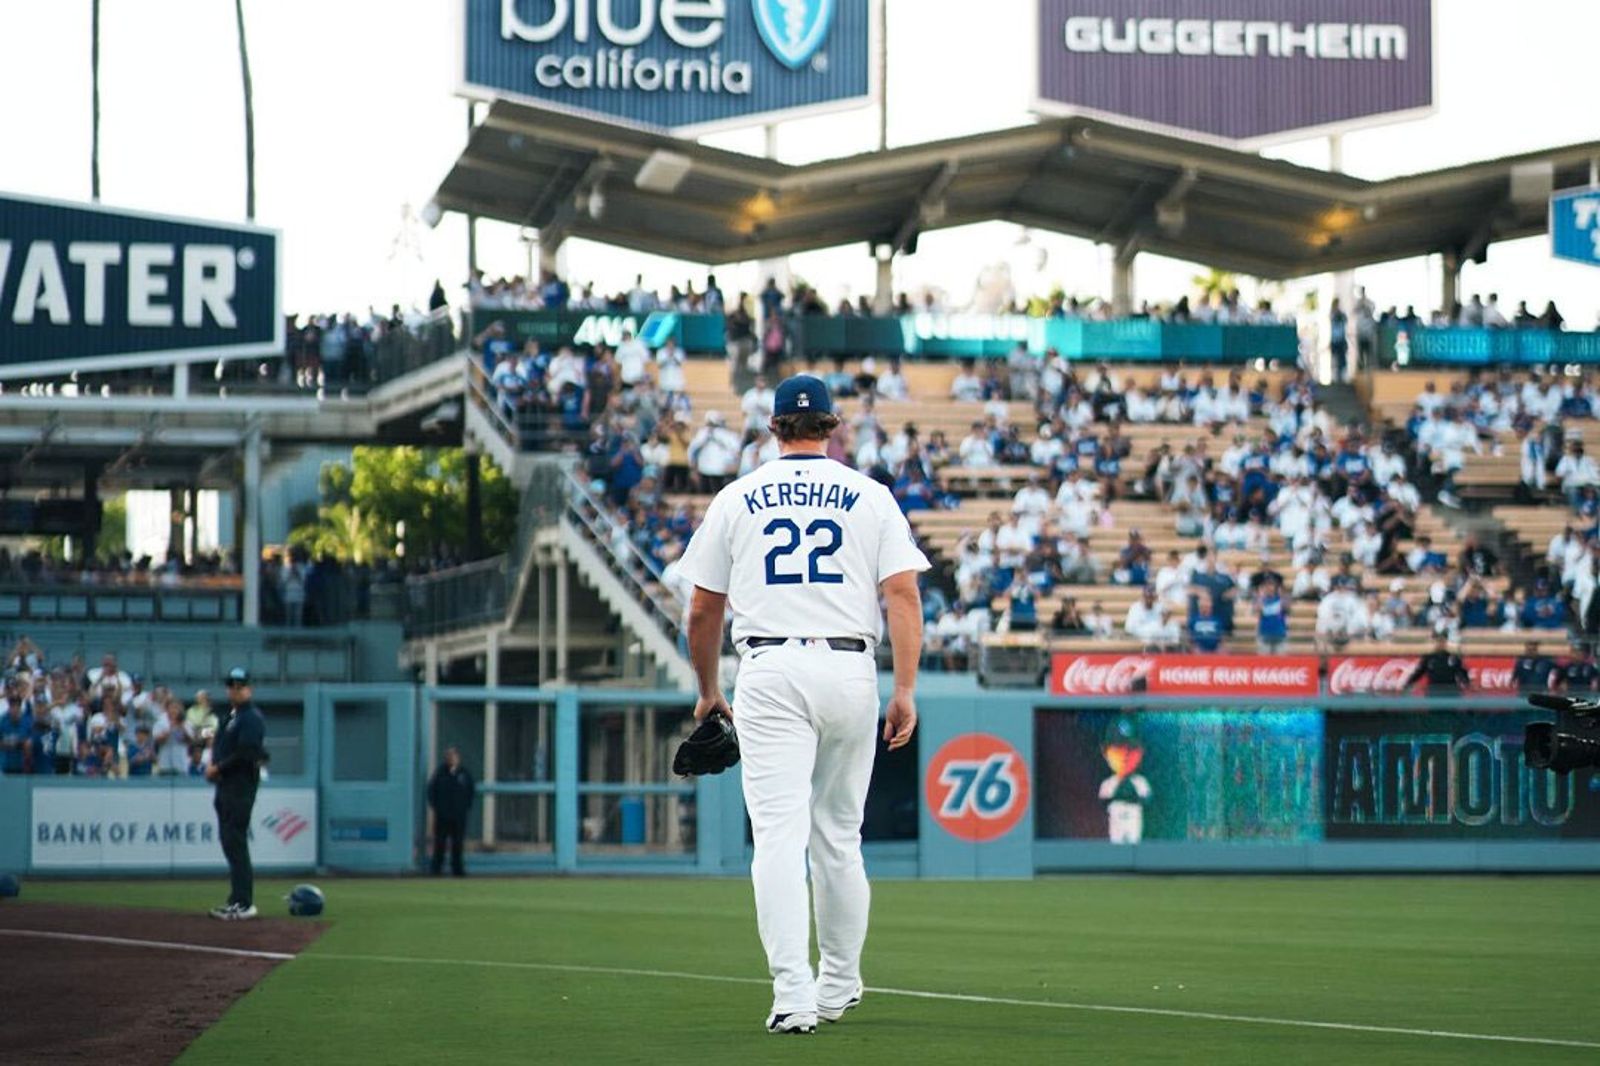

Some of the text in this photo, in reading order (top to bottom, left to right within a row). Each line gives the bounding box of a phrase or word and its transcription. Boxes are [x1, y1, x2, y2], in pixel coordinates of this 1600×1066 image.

[1064, 16, 1408, 60] GUGGENHEIM
[535, 48, 752, 94] california
[0, 238, 238, 329] ATER
[744, 482, 860, 514] KERSHAW
[763, 518, 844, 585] 22
[1063, 656, 1156, 693] Coca-Col
[1159, 665, 1310, 687] HOME RUN MAGIC
[1331, 657, 1419, 694] Coca-Col
[940, 754, 1018, 818] 76
[37, 821, 255, 845] BANK OF AMER
